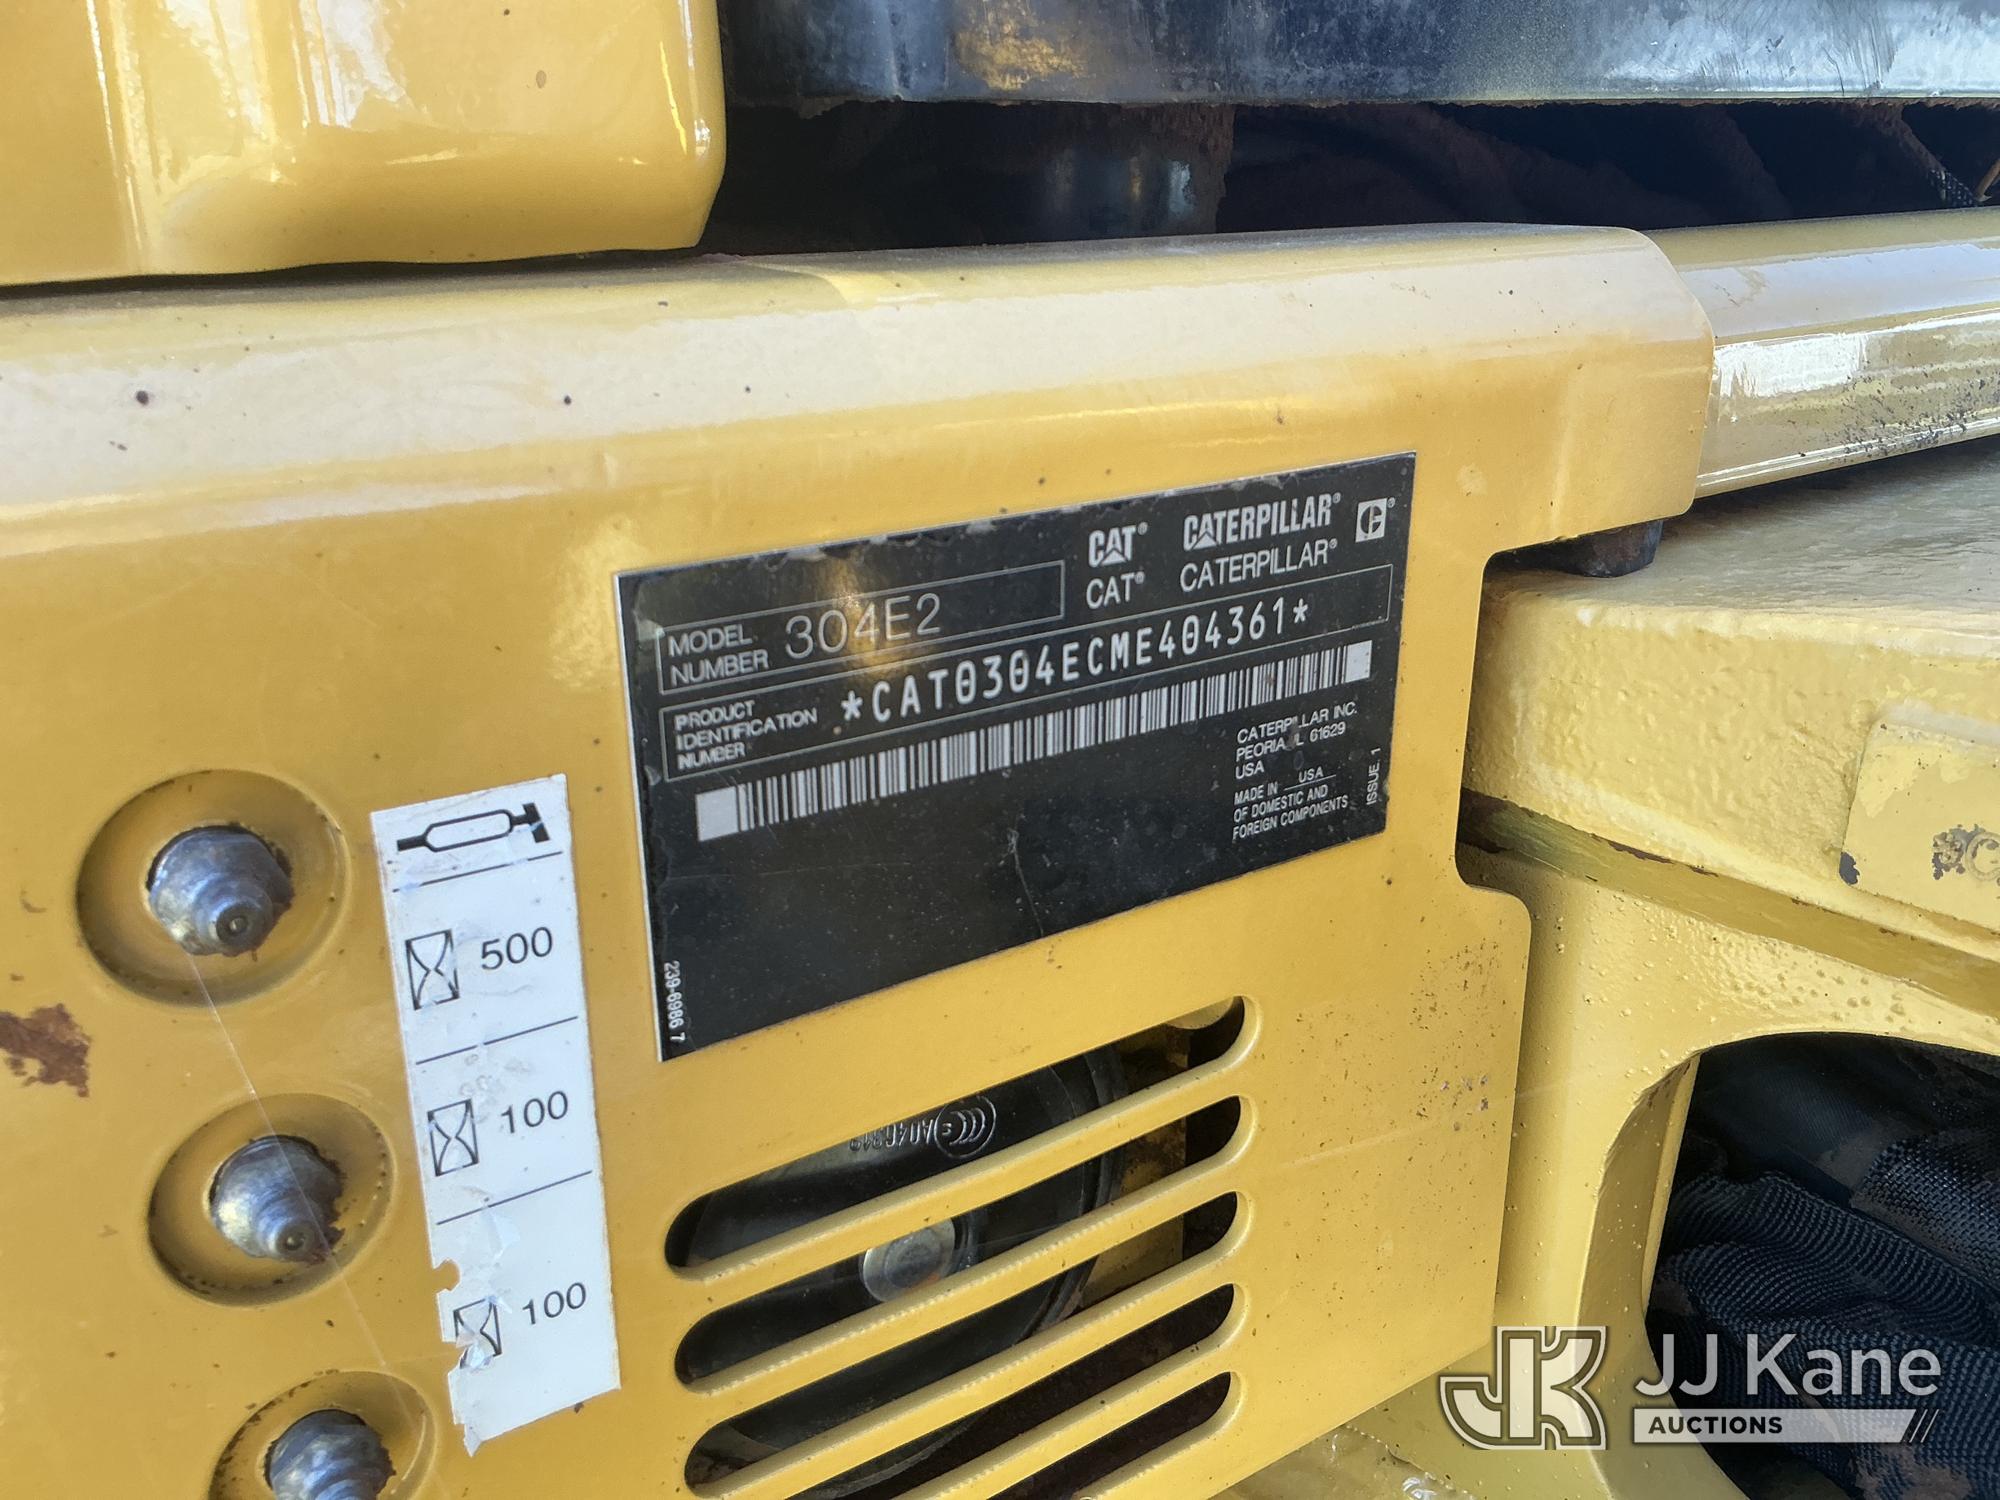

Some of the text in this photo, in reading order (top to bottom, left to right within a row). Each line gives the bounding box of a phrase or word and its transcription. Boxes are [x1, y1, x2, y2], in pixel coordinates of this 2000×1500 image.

[668, 624, 752, 657] MODEL
[785, 593, 941, 659] 304E2
[670, 649, 769, 687] NUMBER
[674, 700, 755, 731] PRODUCT
[675, 707, 818, 751] IDENTIFICATION
[1333, 701, 1357, 720] INC.
[678, 743, 746, 770] NUMBER
[1236, 737, 1286, 762] PEORIA
[1310, 721, 1346, 742] 61629
[1234, 766, 1324, 805] MADE IN USA
[1235, 761, 1264, 779] USA
[1232, 795, 1348, 840] FOREIGN COMPONENTS
[1234, 784, 1328, 822] OF DOMESTIC AND
[480, 926, 553, 972] 500
[500, 1090, 569, 1134] 100
[522, 1282, 587, 1325] 100
